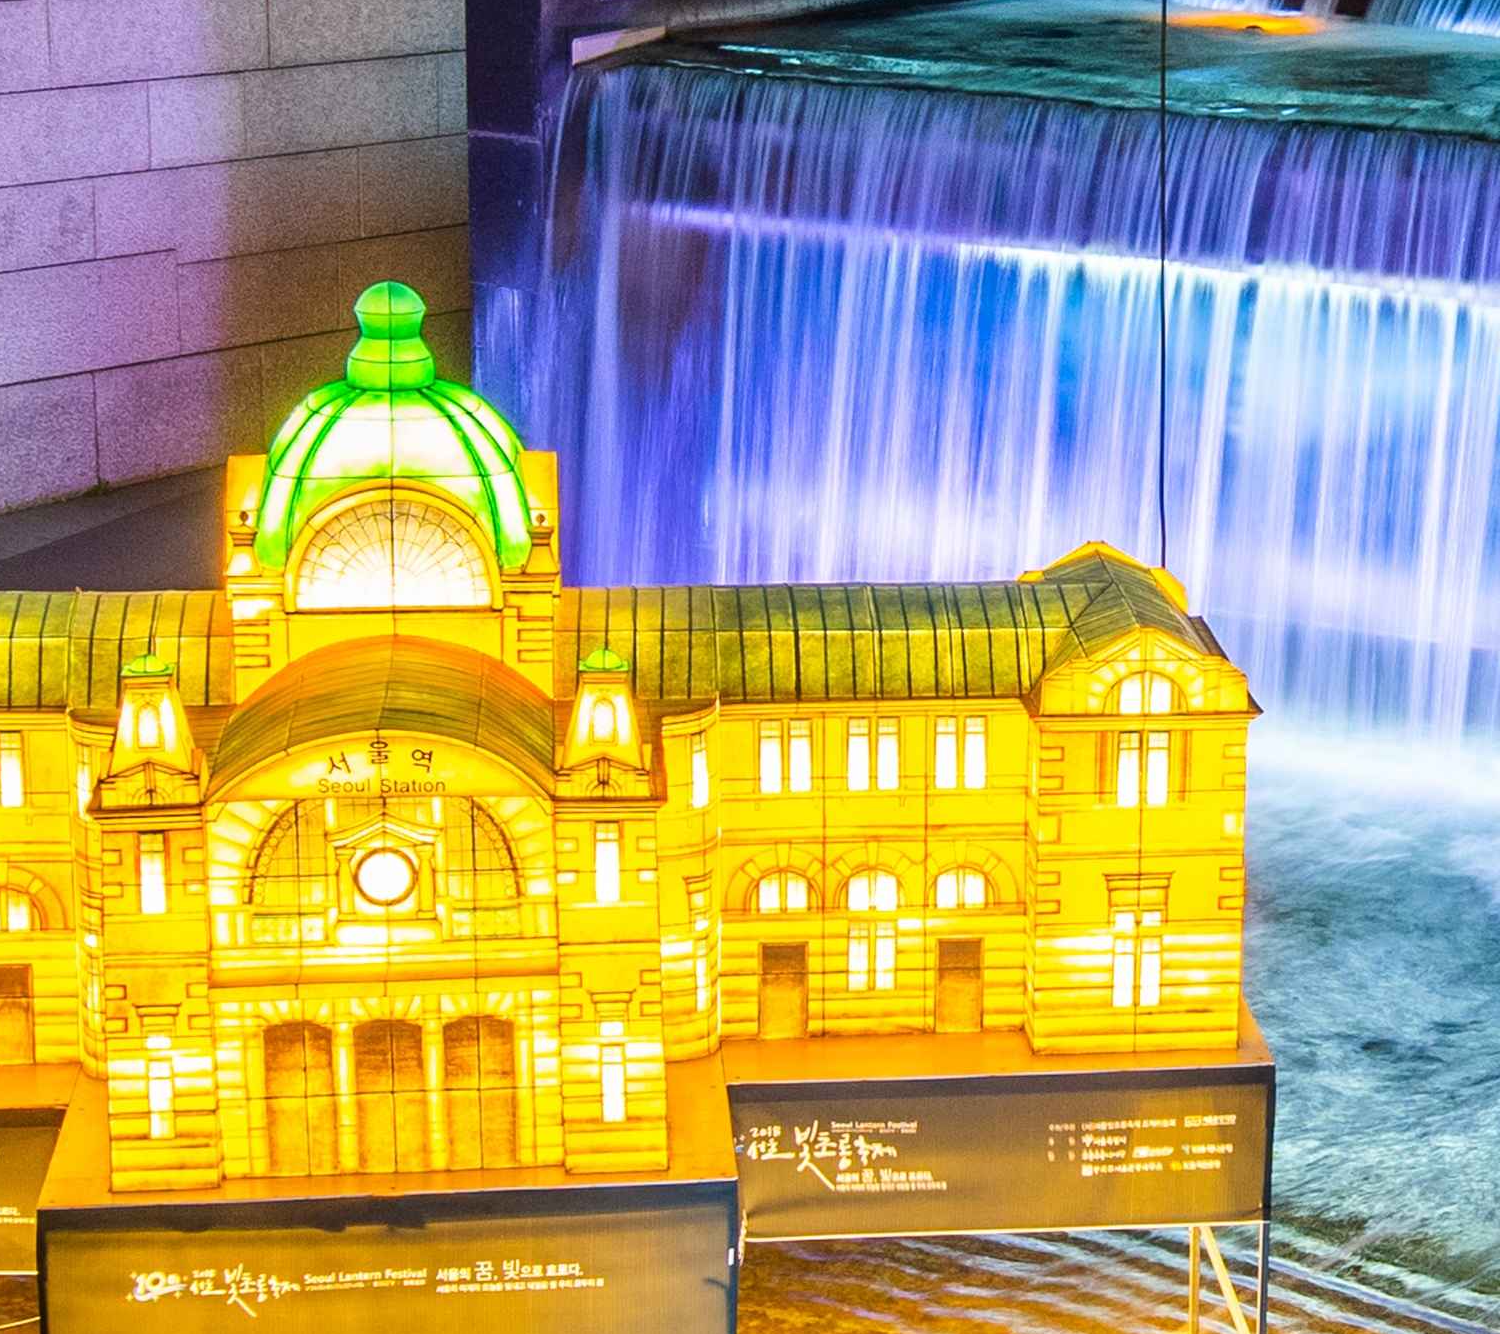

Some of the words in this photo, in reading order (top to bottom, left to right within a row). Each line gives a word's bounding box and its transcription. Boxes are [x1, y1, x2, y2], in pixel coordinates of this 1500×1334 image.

[750, 1126, 781, 1138] 2018
[303, 1272, 336, 1284] Seoul
[338, 1271, 382, 1282] Lantern
[384, 1268, 428, 1279] Festival
[436, 1267, 472, 1282] 서울의
[502, 1259, 544, 1280] 빛으로
